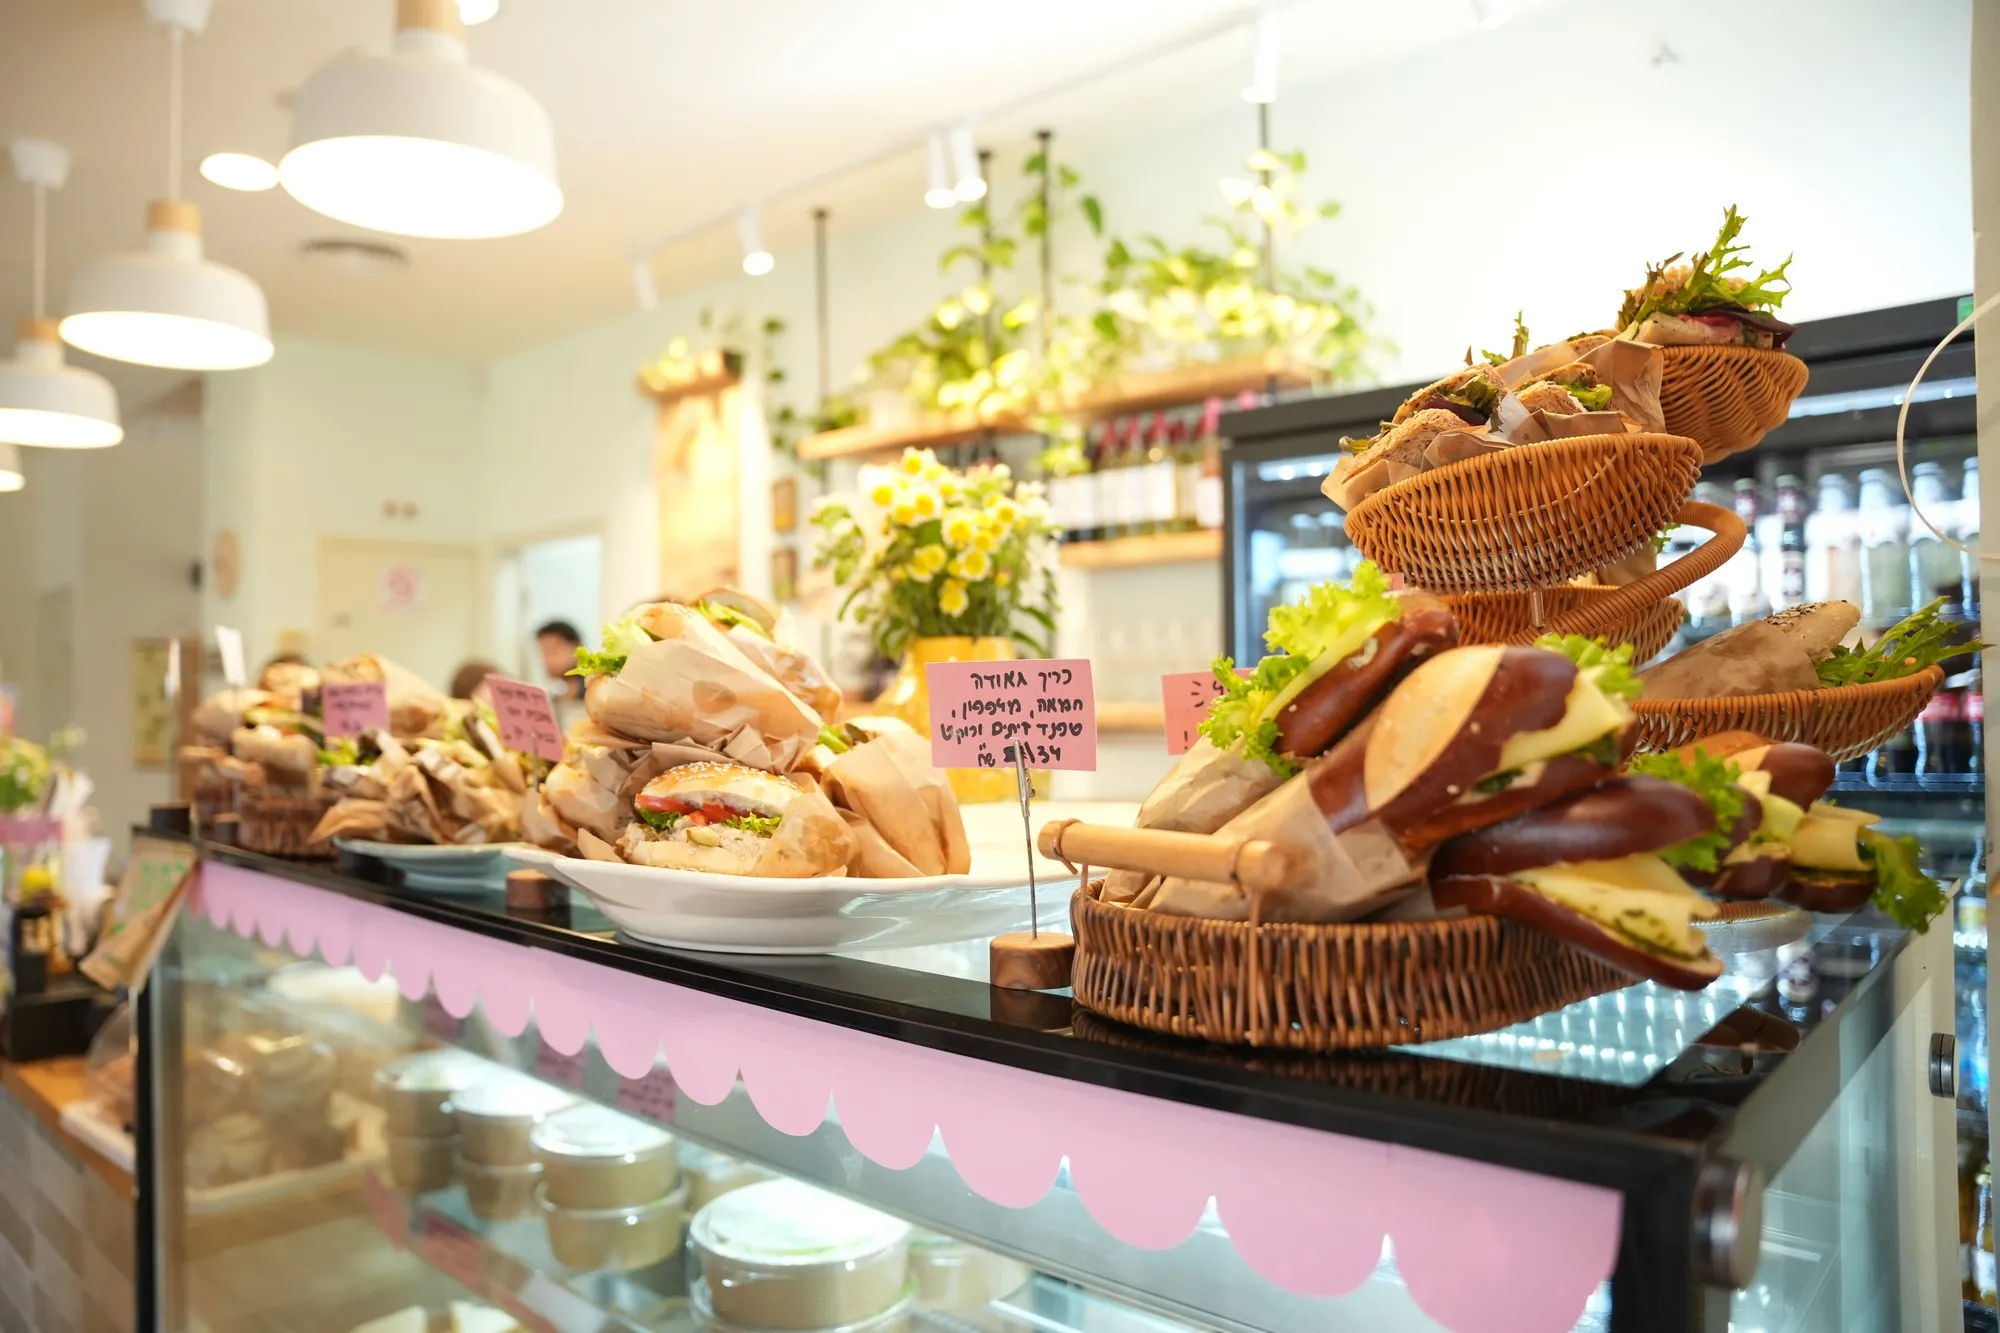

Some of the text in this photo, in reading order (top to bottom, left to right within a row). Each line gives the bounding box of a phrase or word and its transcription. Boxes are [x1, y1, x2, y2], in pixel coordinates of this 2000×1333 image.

[970, 669, 1073, 692] כריך גאודה
[940, 723, 983, 744] ורוקט
[1036, 721, 1083, 740] טפנד
